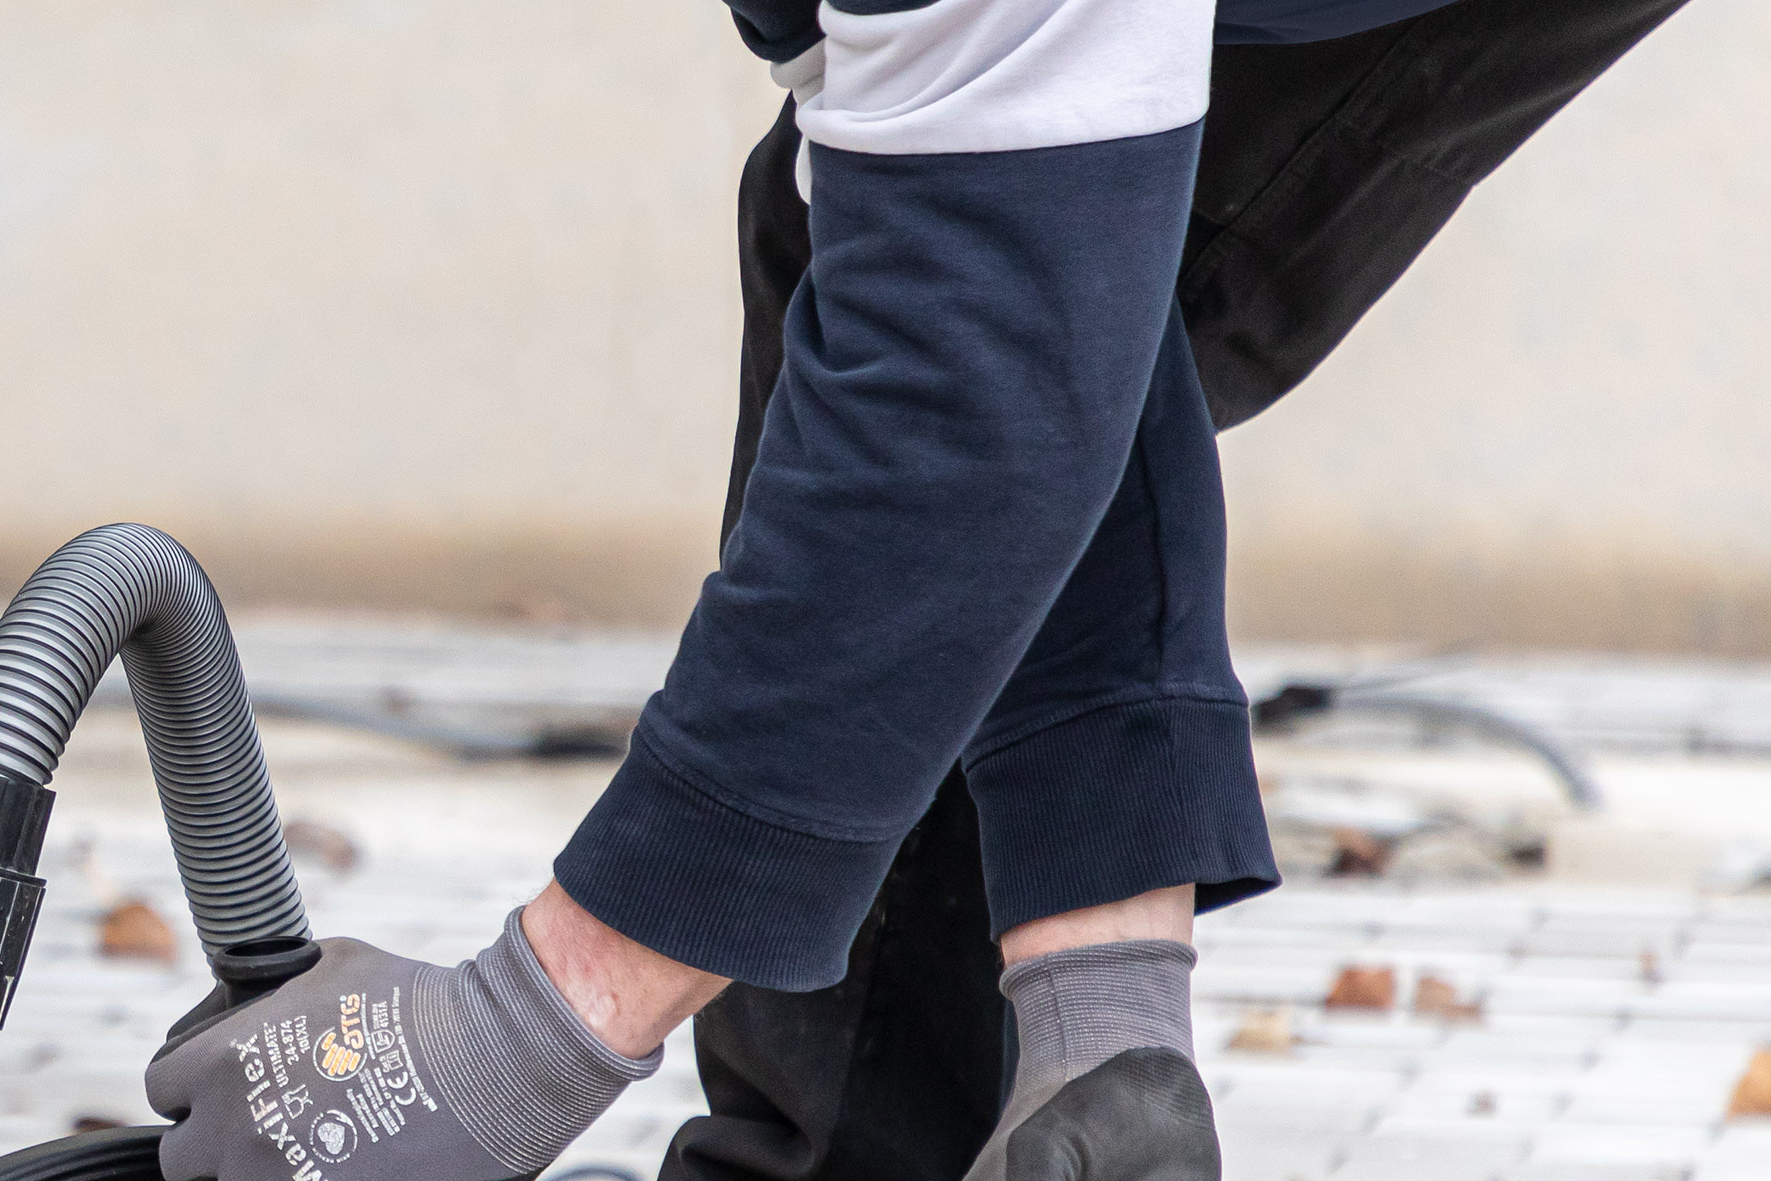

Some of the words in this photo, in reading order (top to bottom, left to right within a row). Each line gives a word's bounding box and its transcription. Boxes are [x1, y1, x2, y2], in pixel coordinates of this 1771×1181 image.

[378, 1001, 389, 1028] 4131A
[280, 1020, 299, 1066] 34-874
[294, 1015, 311, 1054] 10(XL)
